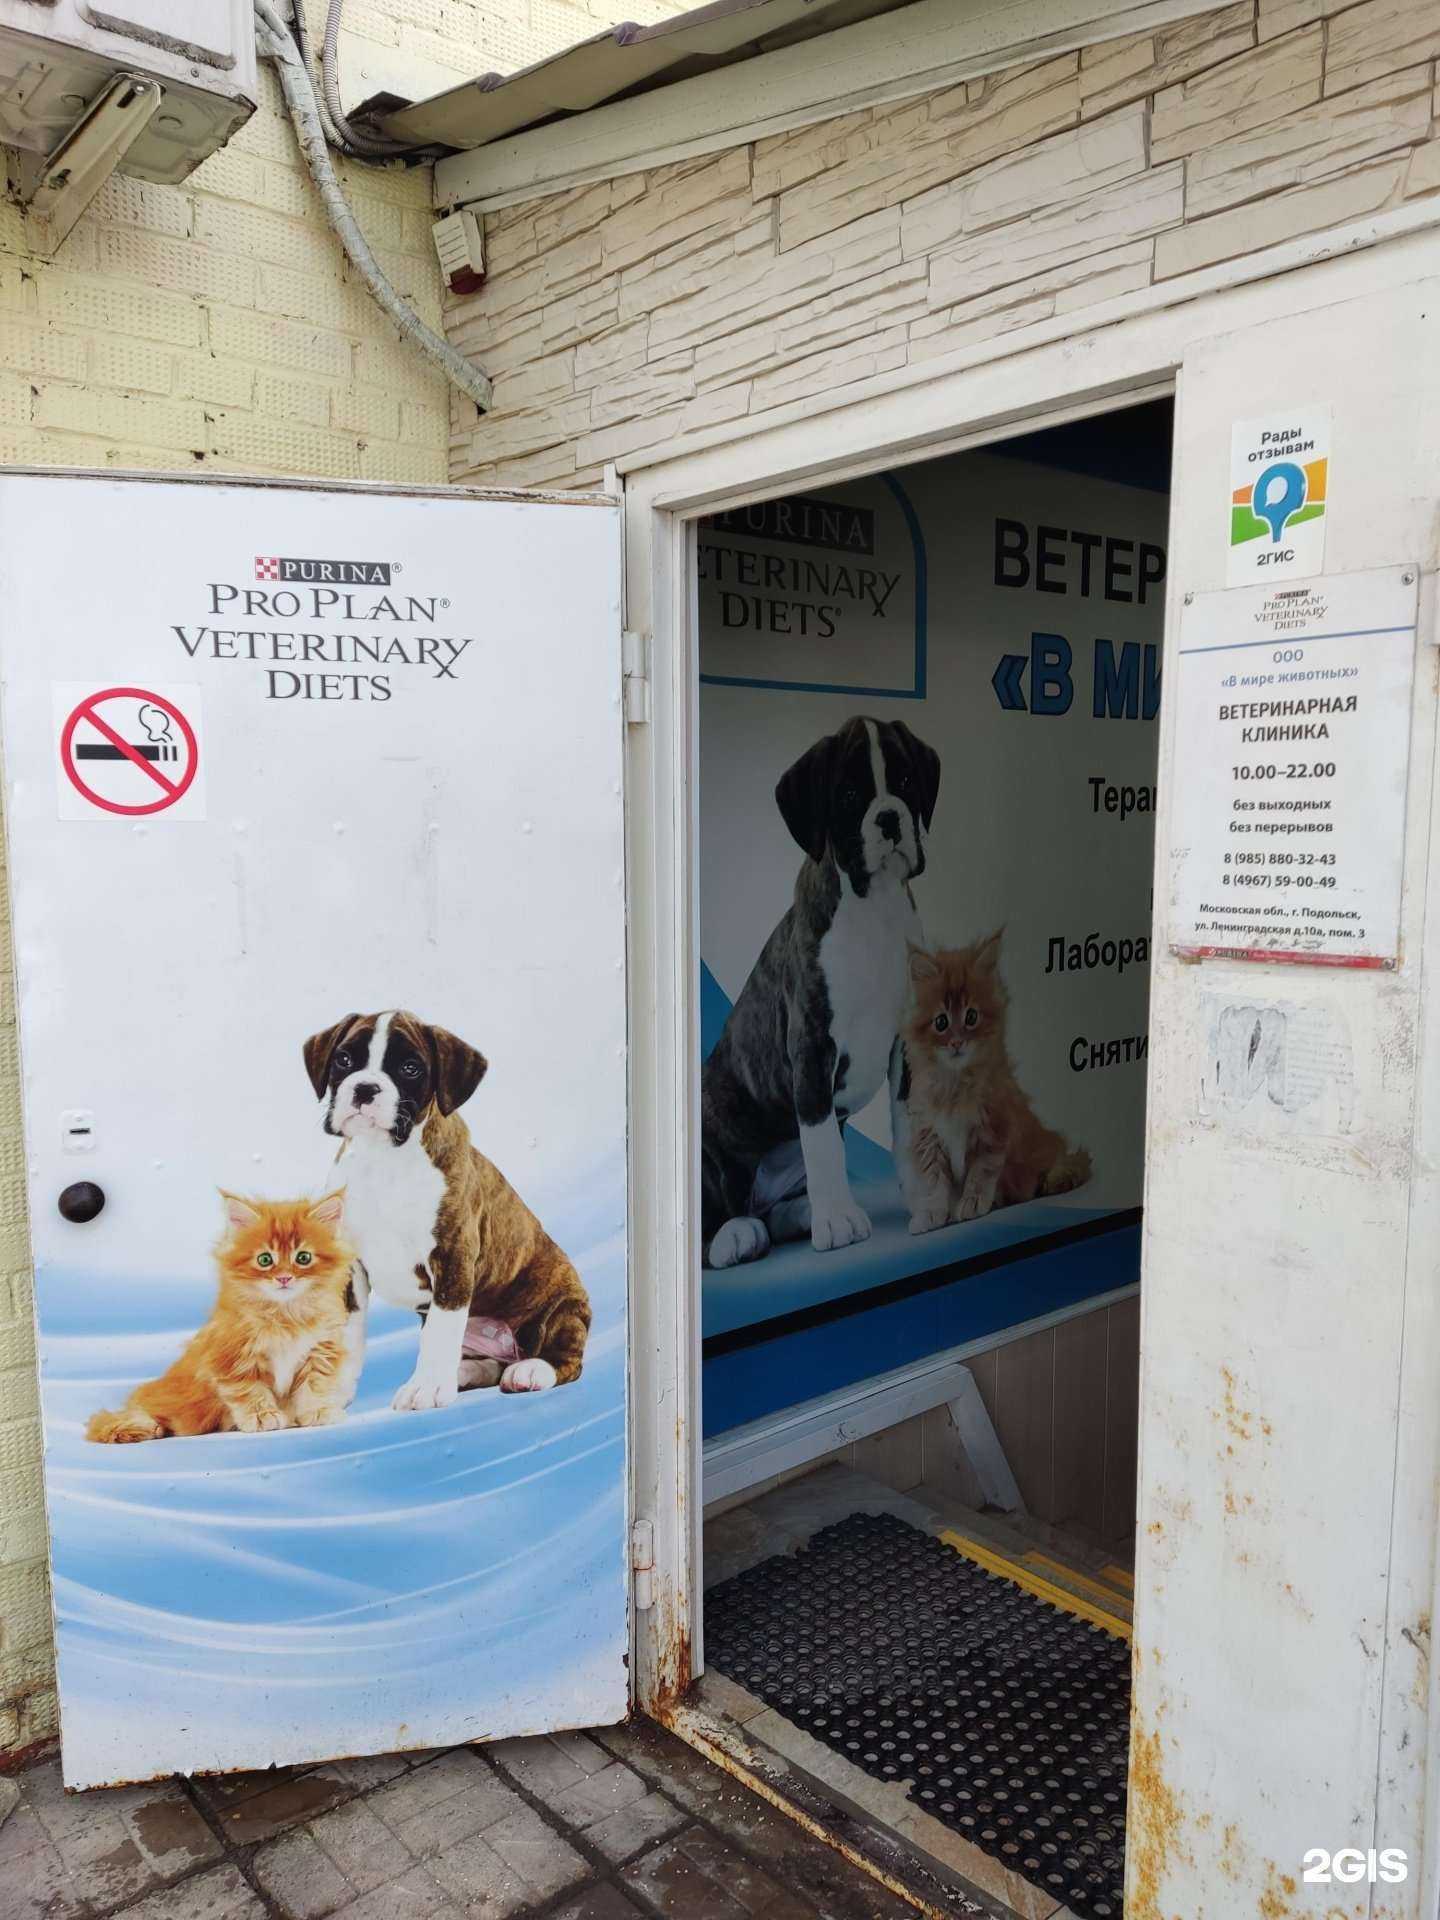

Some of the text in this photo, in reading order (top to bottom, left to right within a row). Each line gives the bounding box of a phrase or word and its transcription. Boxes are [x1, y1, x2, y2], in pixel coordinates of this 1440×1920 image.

[1261, 428, 1302, 445] Рады
[1247, 440, 1314, 462] отзывам
[994, 517, 1167, 604] ВЕТЕР
[1256, 549, 1295, 567] 2ГИС
[171, 625, 474, 679] VETERINARY
[1272, 649, 1304, 664] ООО
[265, 669, 392, 702] DIETS
[1221, 666, 1359, 688] «В мире животных»
[1219, 695, 1358, 721] ВЕТЕРИНАРНАЯ
[1241, 723, 1330, 744] КЛИНИКА
[1088, 777, 1157, 822] Тера
[1232, 799, 1332, 812] без выходных
[1229, 820, 1334, 835] без перерывов
[1224, 852, 1337, 866] 8 (985) 880-32-43
[1222, 874, 1337, 888] 8 (4967) 59-00-49
[1199, 903, 1261, 915] Московская
[1263, 905, 1289, 918] обл.,
[1301, 907, 1362, 921] Подольск,
[1195, 923, 1209, 932] ул.
[1210, 922, 1291, 935] Ленинградская
[1328, 929, 1356, 938] пом.
[1358, 928, 1366, 938] 3
[1045, 932, 1152, 973] Лабора
